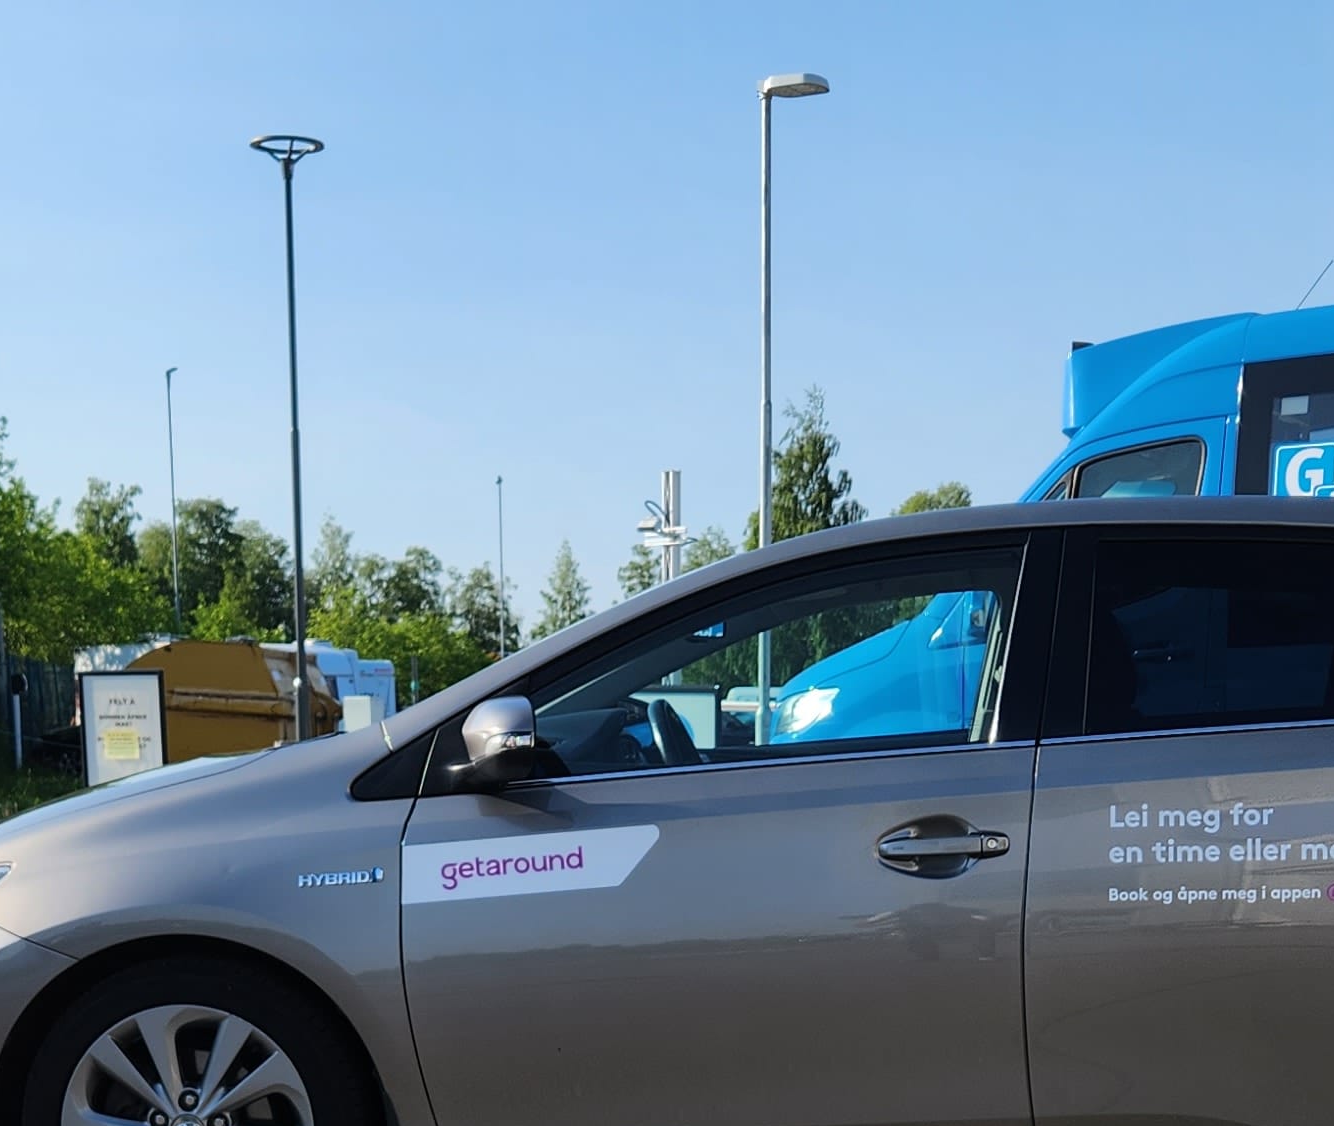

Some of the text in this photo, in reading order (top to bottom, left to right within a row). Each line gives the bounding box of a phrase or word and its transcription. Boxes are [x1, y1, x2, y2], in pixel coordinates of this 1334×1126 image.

[1108, 802, 1275, 834] Lei meg for
[1108, 845, 1144, 864] en
[1151, 838, 1221, 863] time
[1228, 837, 1292, 862] eller
[297, 871, 371, 888] HYBRID
[440, 845, 584, 891] getaround
[1108, 885, 1322, 905] Book og åpne meg i appen
